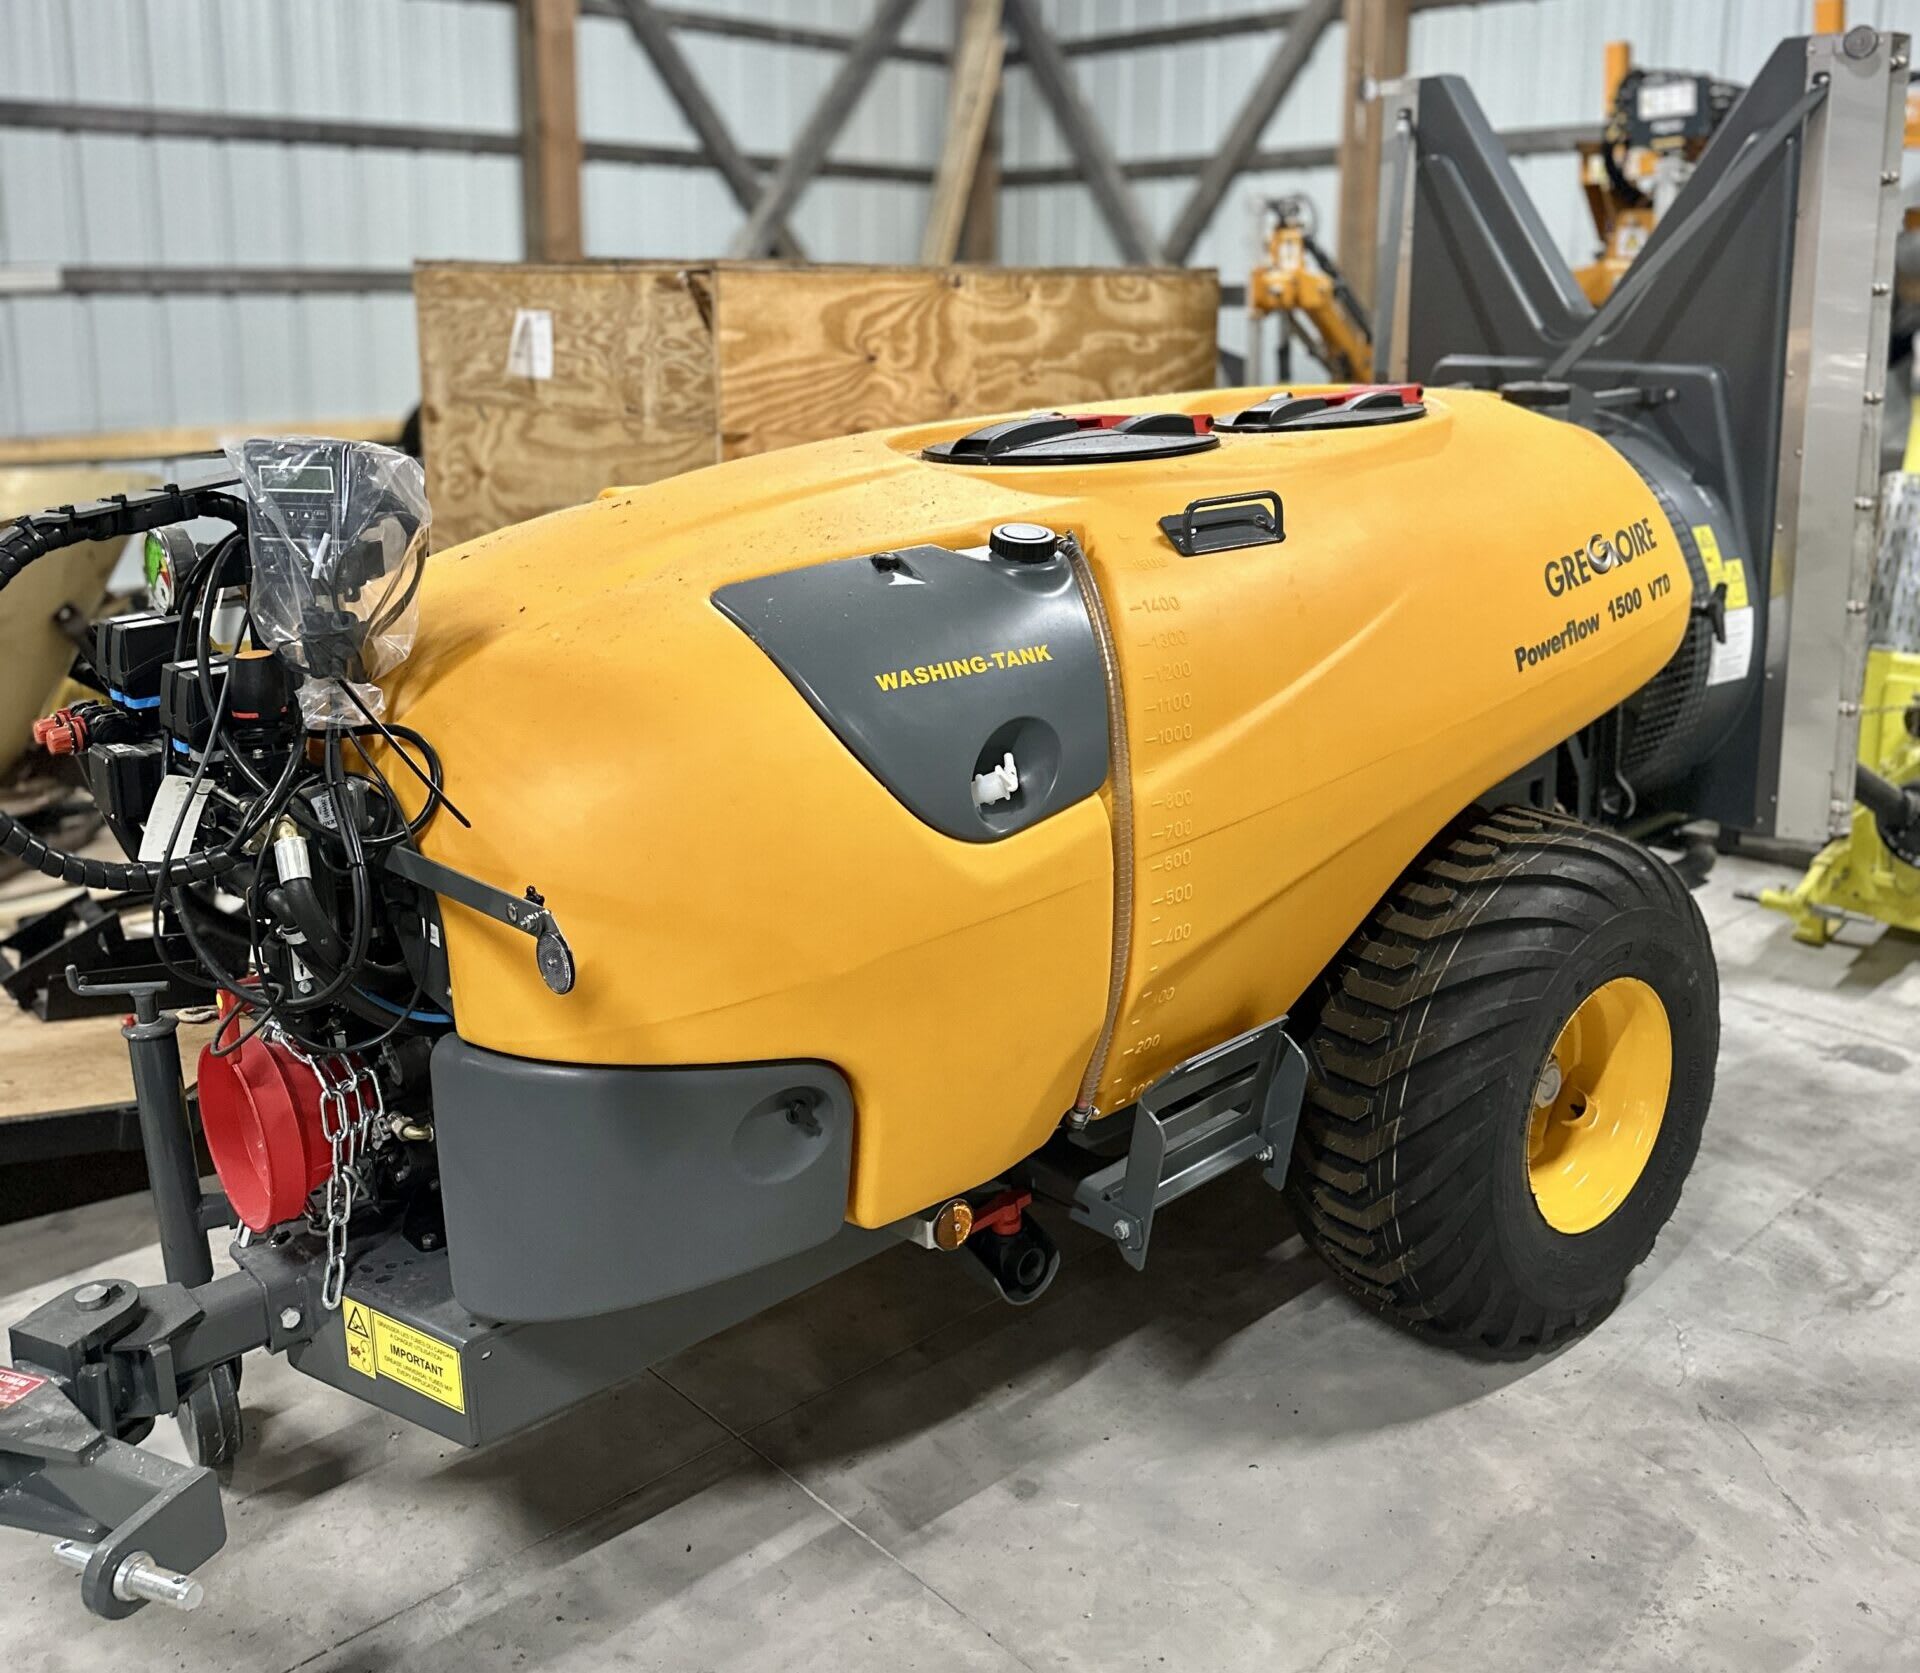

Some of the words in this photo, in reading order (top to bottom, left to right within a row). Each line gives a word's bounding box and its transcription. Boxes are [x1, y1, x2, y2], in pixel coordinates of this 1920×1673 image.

[1544, 517, 1657, 597] GREGOIRE
[1142, 596, 1180, 613] 1400
[1514, 613, 1600, 673] Powerflow
[1607, 587, 1642, 622] 1500
[1647, 573, 1671, 601] VTD
[1151, 630, 1188, 649] 1300
[874, 644, 1053, 692] WASHING-TANK
[1156, 659, 1192, 682] 1200
[1158, 692, 1193, 713] 1100
[1158, 723, 1193, 744] 1000
[1165, 788, 1193, 809] 800
[1164, 818, 1193, 840] 700
[1164, 849, 1192, 871] 600
[1166, 883, 1193, 905] 500
[1164, 923, 1192, 943] 400
[1134, 1034, 1160, 1055] 200
[390, 1344, 444, 1377] IMPORTANT
